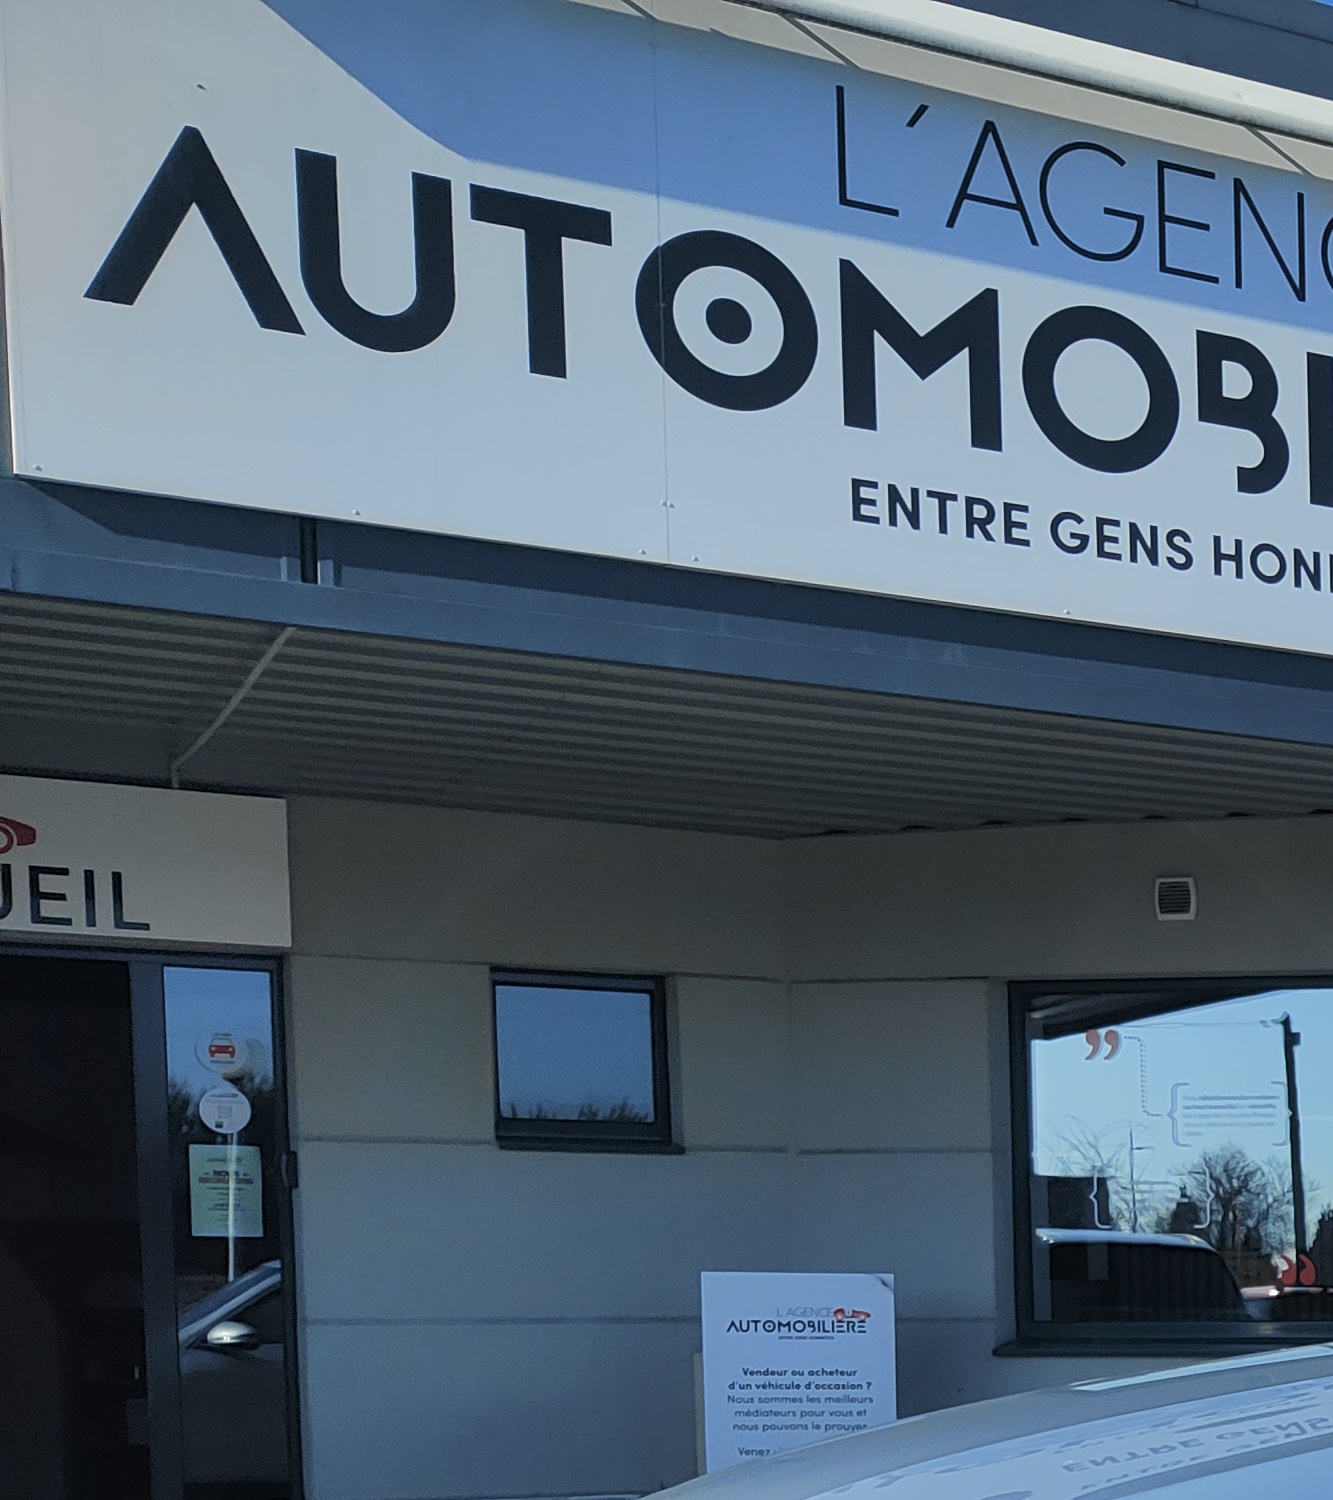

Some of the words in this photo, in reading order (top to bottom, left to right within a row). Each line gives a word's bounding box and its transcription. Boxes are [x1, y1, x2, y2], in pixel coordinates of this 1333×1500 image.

[851, 477, 1031, 548] ENTRE
[1050, 511, 1193, 571] GENS
[726, 1319, 867, 1334] AUTOMOBILIERE
[742, 1367, 788, 1377] Vendeur
[791, 1369, 805, 1377] ou
[807, 1367, 858, 1377] acheteur
[755, 1381, 801, 1390] véhicule
[804, 1381, 863, 1390] d'occasion
[866, 1381, 872, 1390] ?
[727, 1395, 755, 1404] Nous
[757, 1396, 804, 1404] sommes
[806, 1394, 821, 1404] les
[824, 1394, 874, 1404] meilleurs
[734, 1408, 797, 1418] médiateurs
[800, 1410, 826, 1419] pour
[828, 1409, 854, 1418] vous
[856, 1409, 867, 1417] et
[732, 1423, 759, 1431] nous
[762, 1423, 809, 1433] pouvons
[811, 1421, 821, 1431] le
